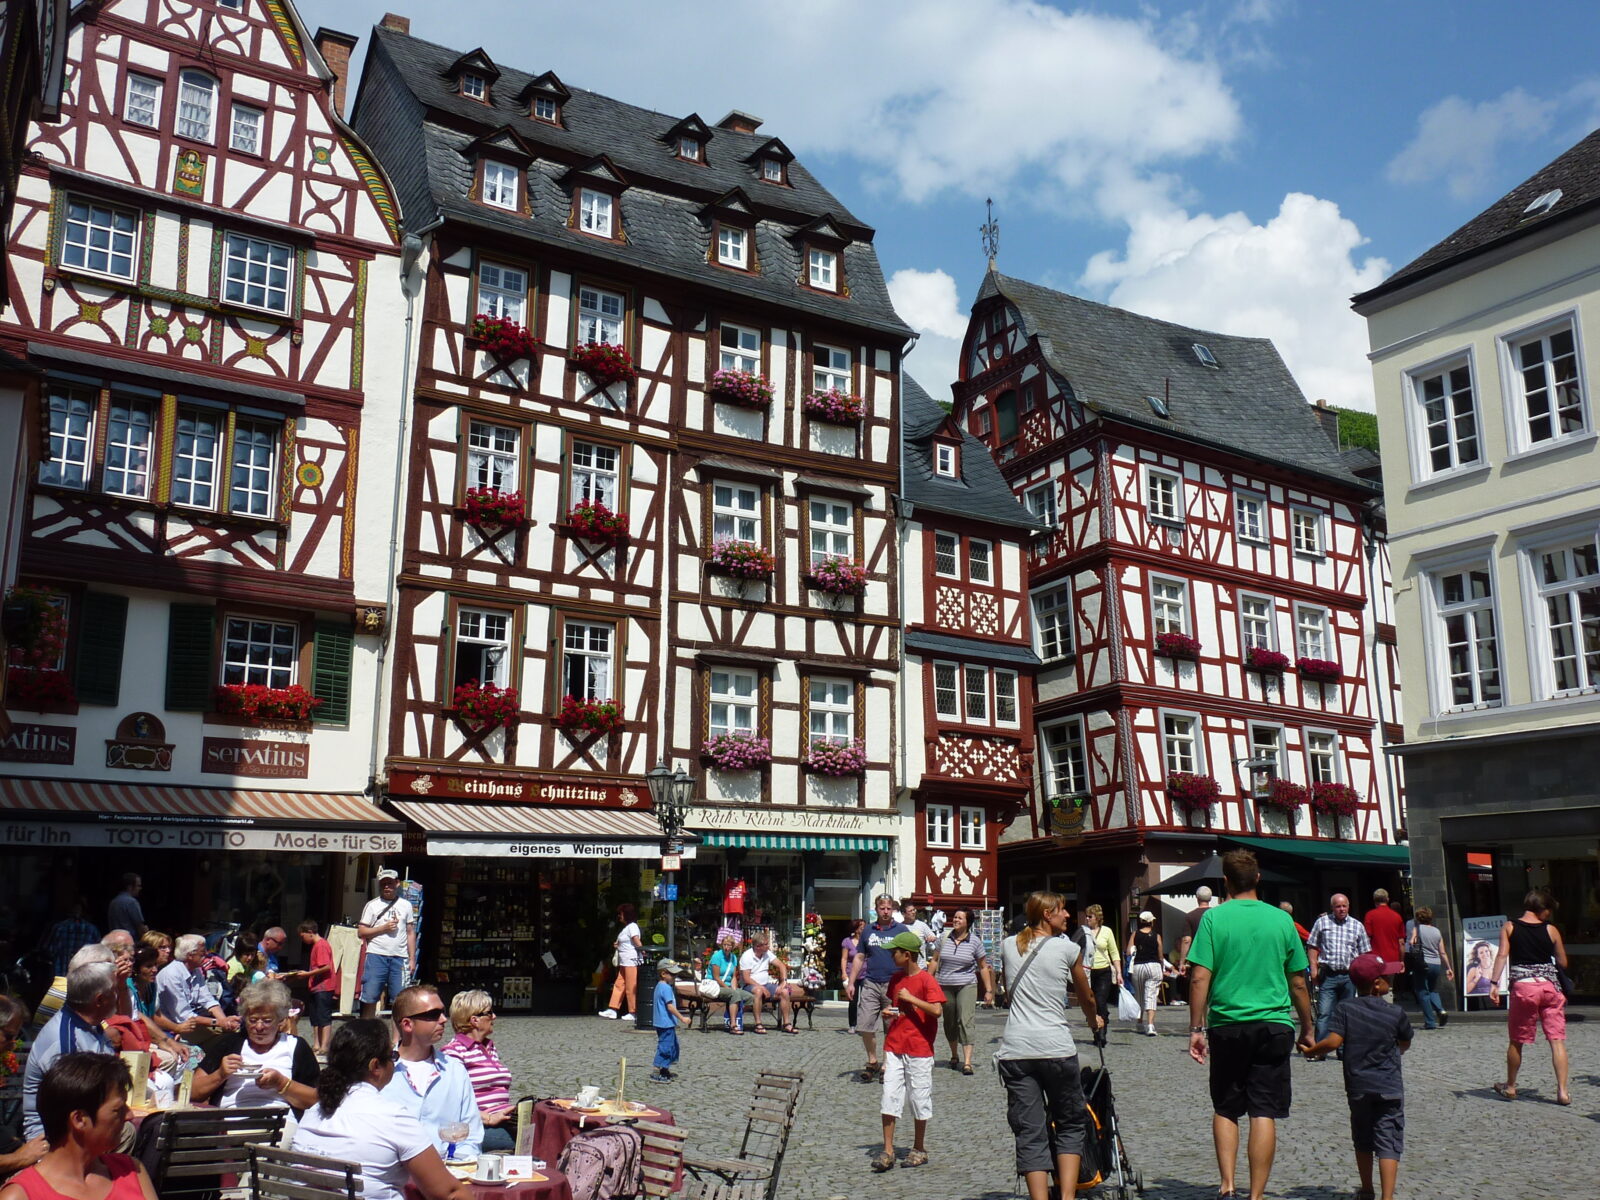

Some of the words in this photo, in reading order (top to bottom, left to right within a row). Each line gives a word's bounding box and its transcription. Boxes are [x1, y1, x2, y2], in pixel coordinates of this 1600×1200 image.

[207, 743, 305, 768] servatius
[448, 779, 523, 798] Weinhaus
[530, 783, 607, 802] Schnitzius
[745, 812, 786, 828] Kleine
[791, 814, 864, 830] Markthalle
[6, 824, 35, 843] für
[41, 825, 71, 844] Ihn
[105, 828, 163, 845] TOTO
[180, 830, 245, 847] LOTTO
[274, 832, 329, 849] Mode
[341, 834, 366, 850] für
[369, 835, 397, 850] Sie
[510, 843, 561, 856] eigenes
[573, 843, 624, 857] Weingut
